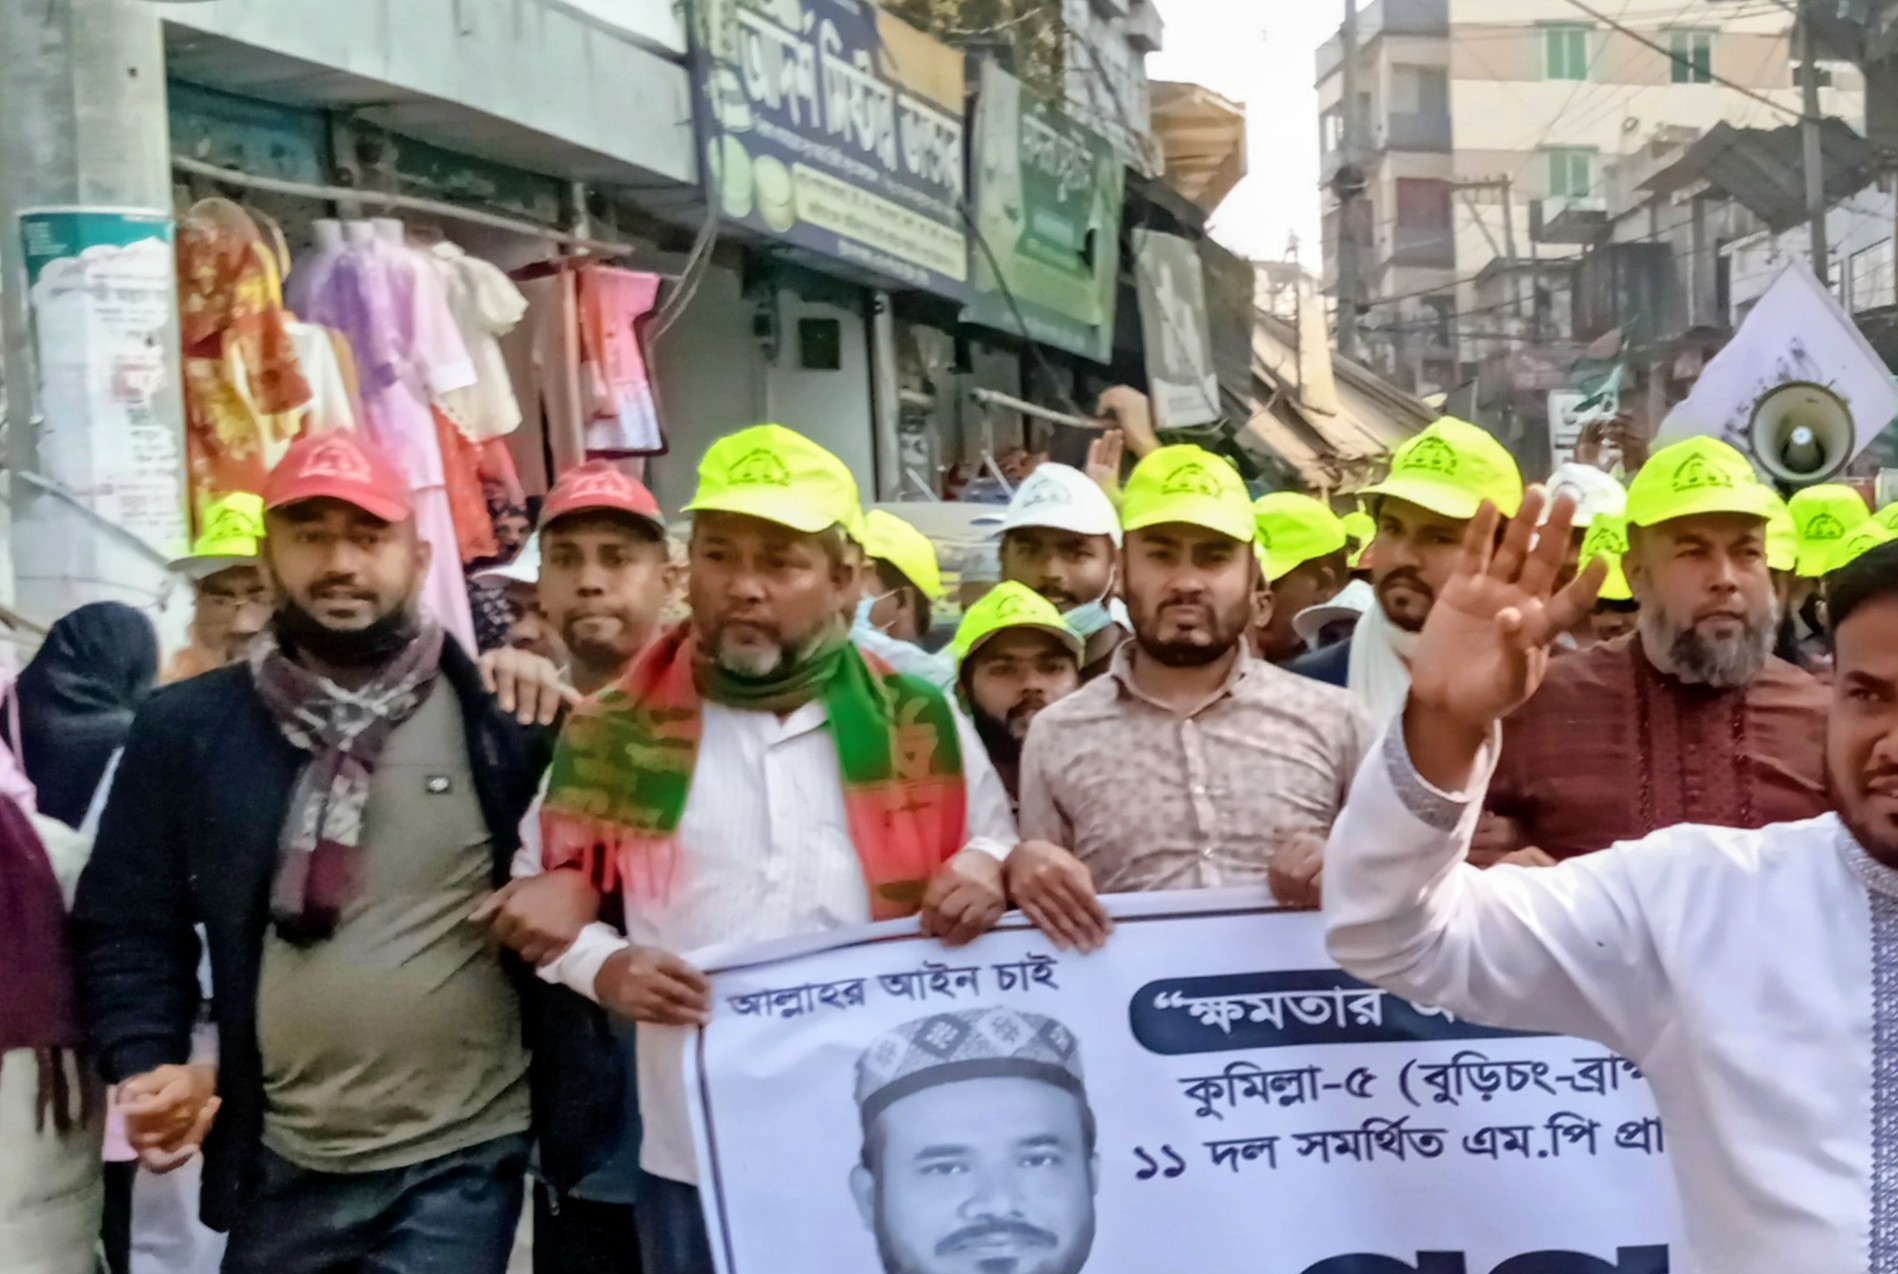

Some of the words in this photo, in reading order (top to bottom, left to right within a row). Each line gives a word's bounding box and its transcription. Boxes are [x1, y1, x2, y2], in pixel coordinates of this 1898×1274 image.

[726, 977, 867, 1018] আল্লাহর
[877, 960, 982, 1000] আইন
[991, 952, 1060, 993] চাই
[1133, 1143, 1188, 1180] ১১
[1203, 1136, 1281, 1173] দল
[1292, 1115, 1448, 1164] সমর্থিত
[1462, 1111, 1602, 1160] এম.পি
[1614, 1115, 1665, 1155] প্রা
